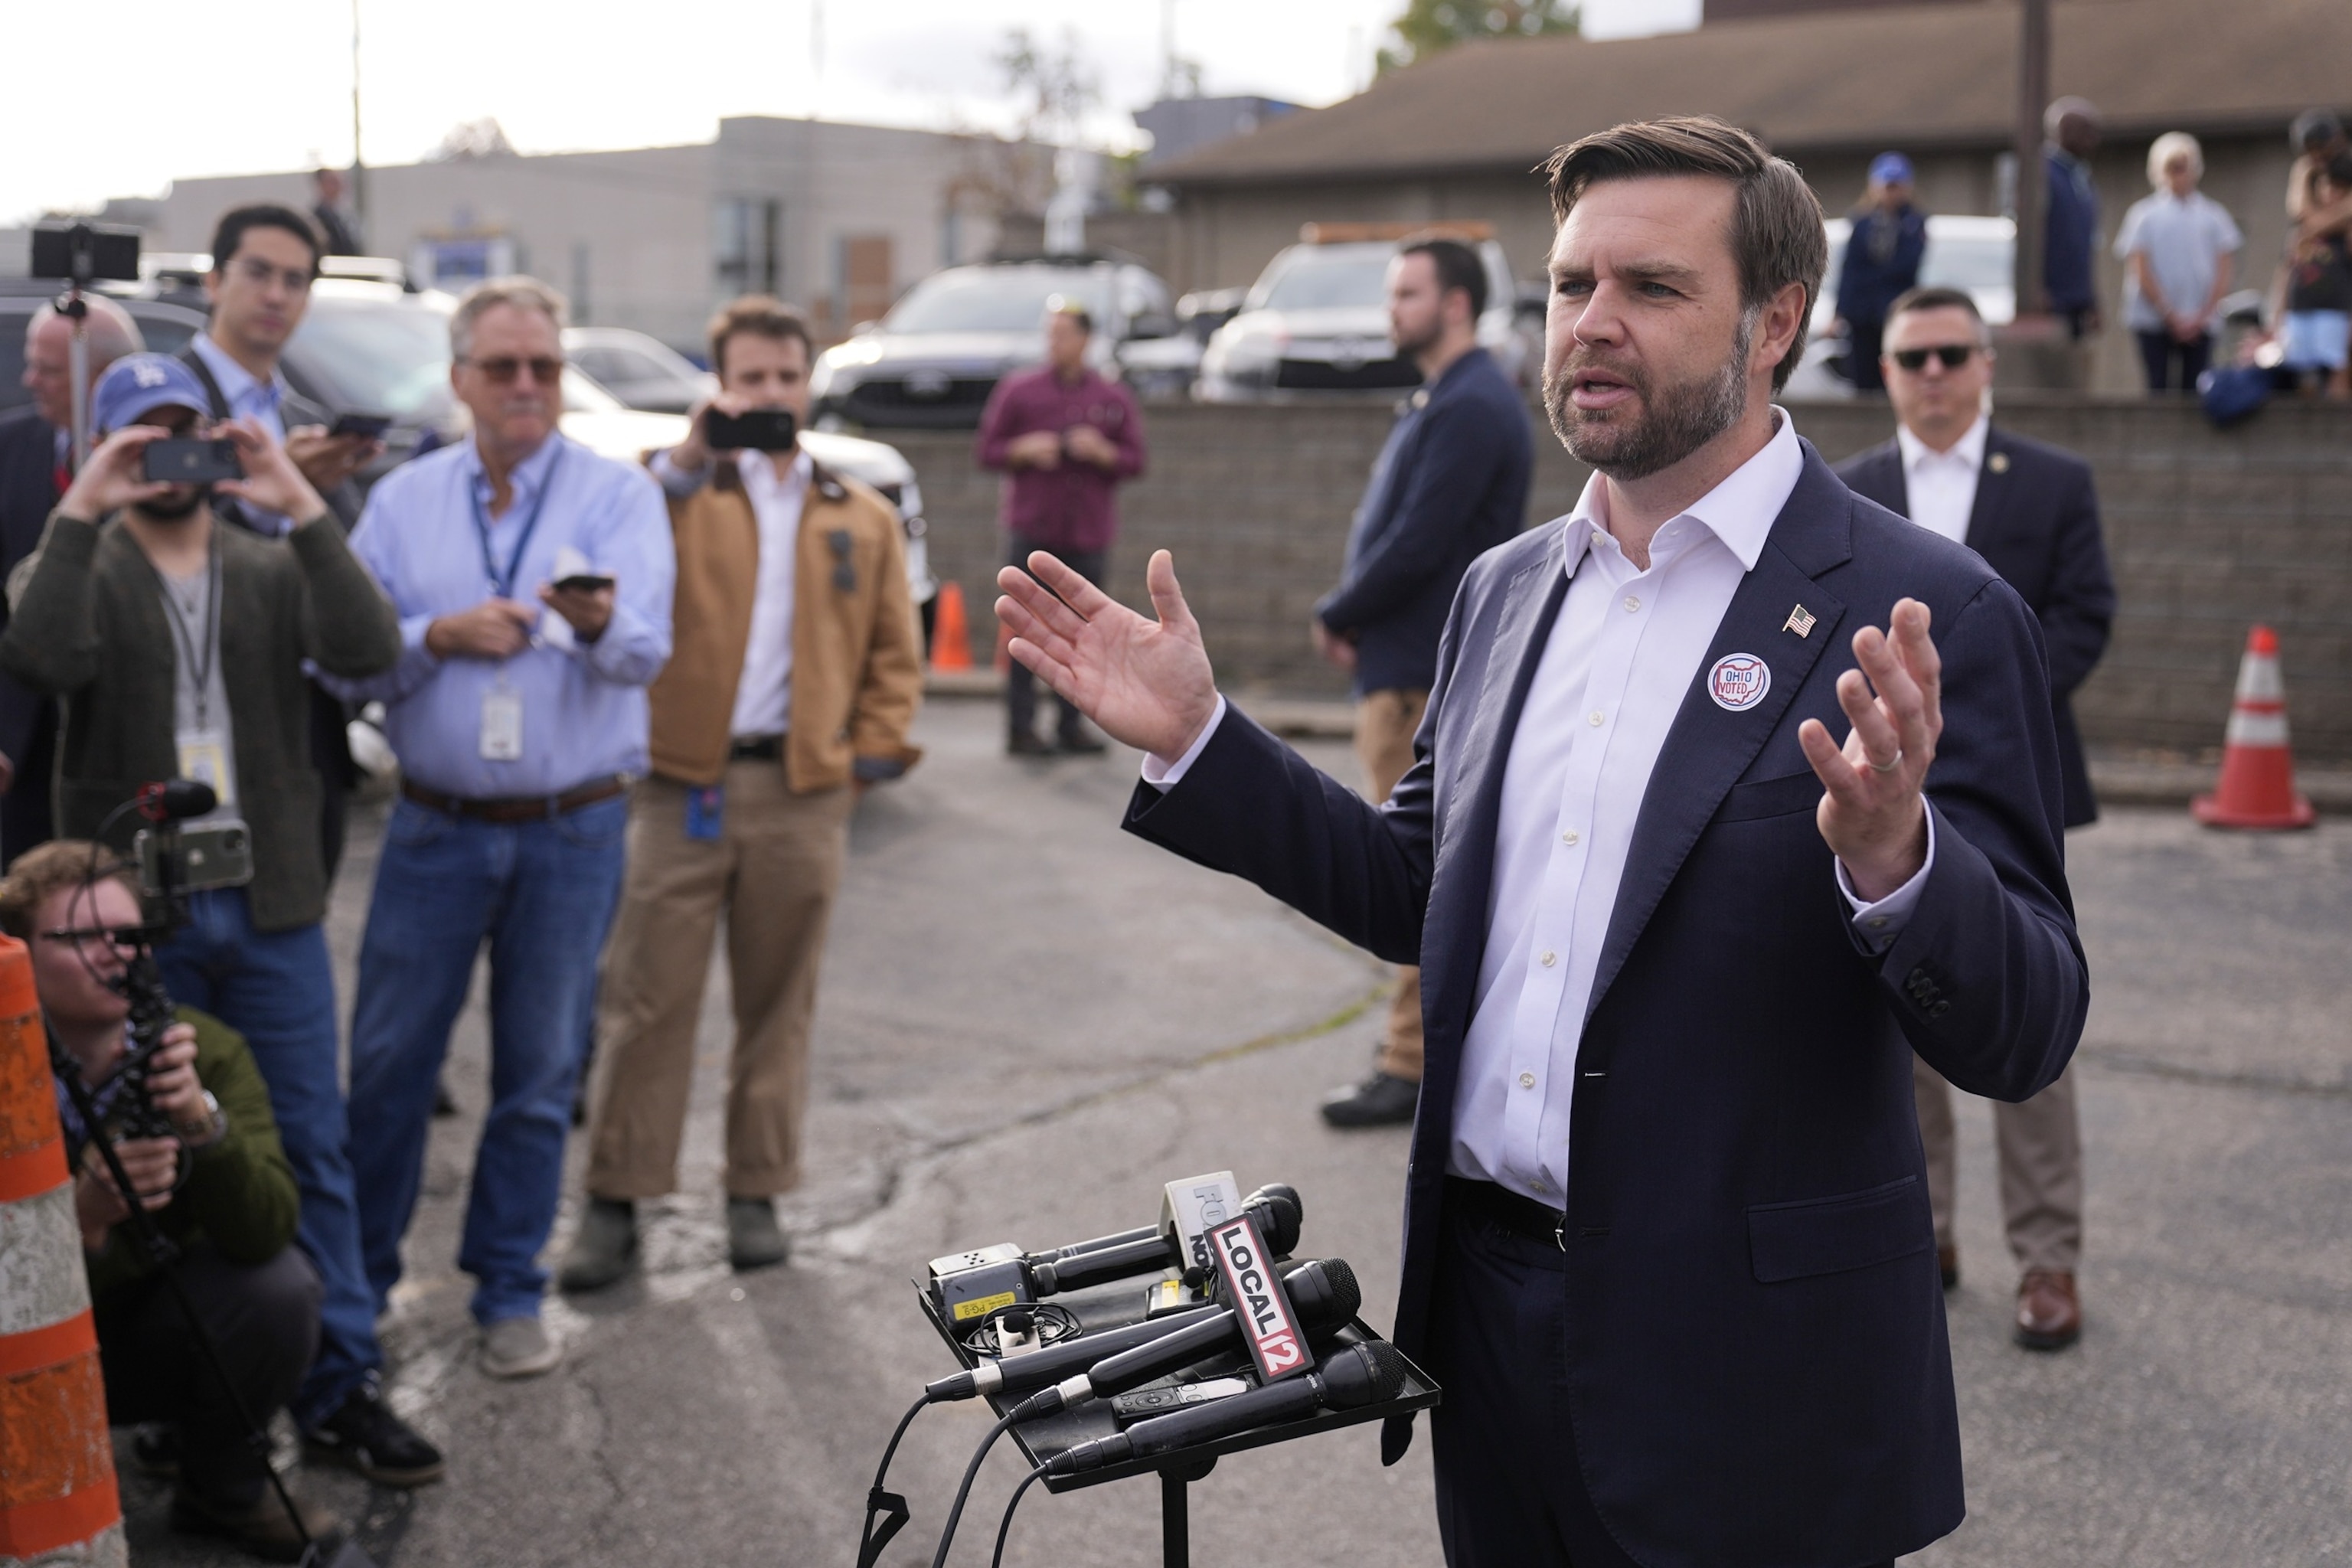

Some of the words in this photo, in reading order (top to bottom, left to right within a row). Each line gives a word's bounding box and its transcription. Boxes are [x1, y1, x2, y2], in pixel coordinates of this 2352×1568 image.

[1720, 682, 1747, 694] VOTED
[1726, 671, 1752, 682] OHIO
[1194, 1184, 1227, 1230] FO
[1190, 1233, 1210, 1267] NO
[965, 1305, 985, 1315] PG-9
[1221, 1227, 1276, 1335] LOCAL
[1259, 1334, 1299, 1373] 12
